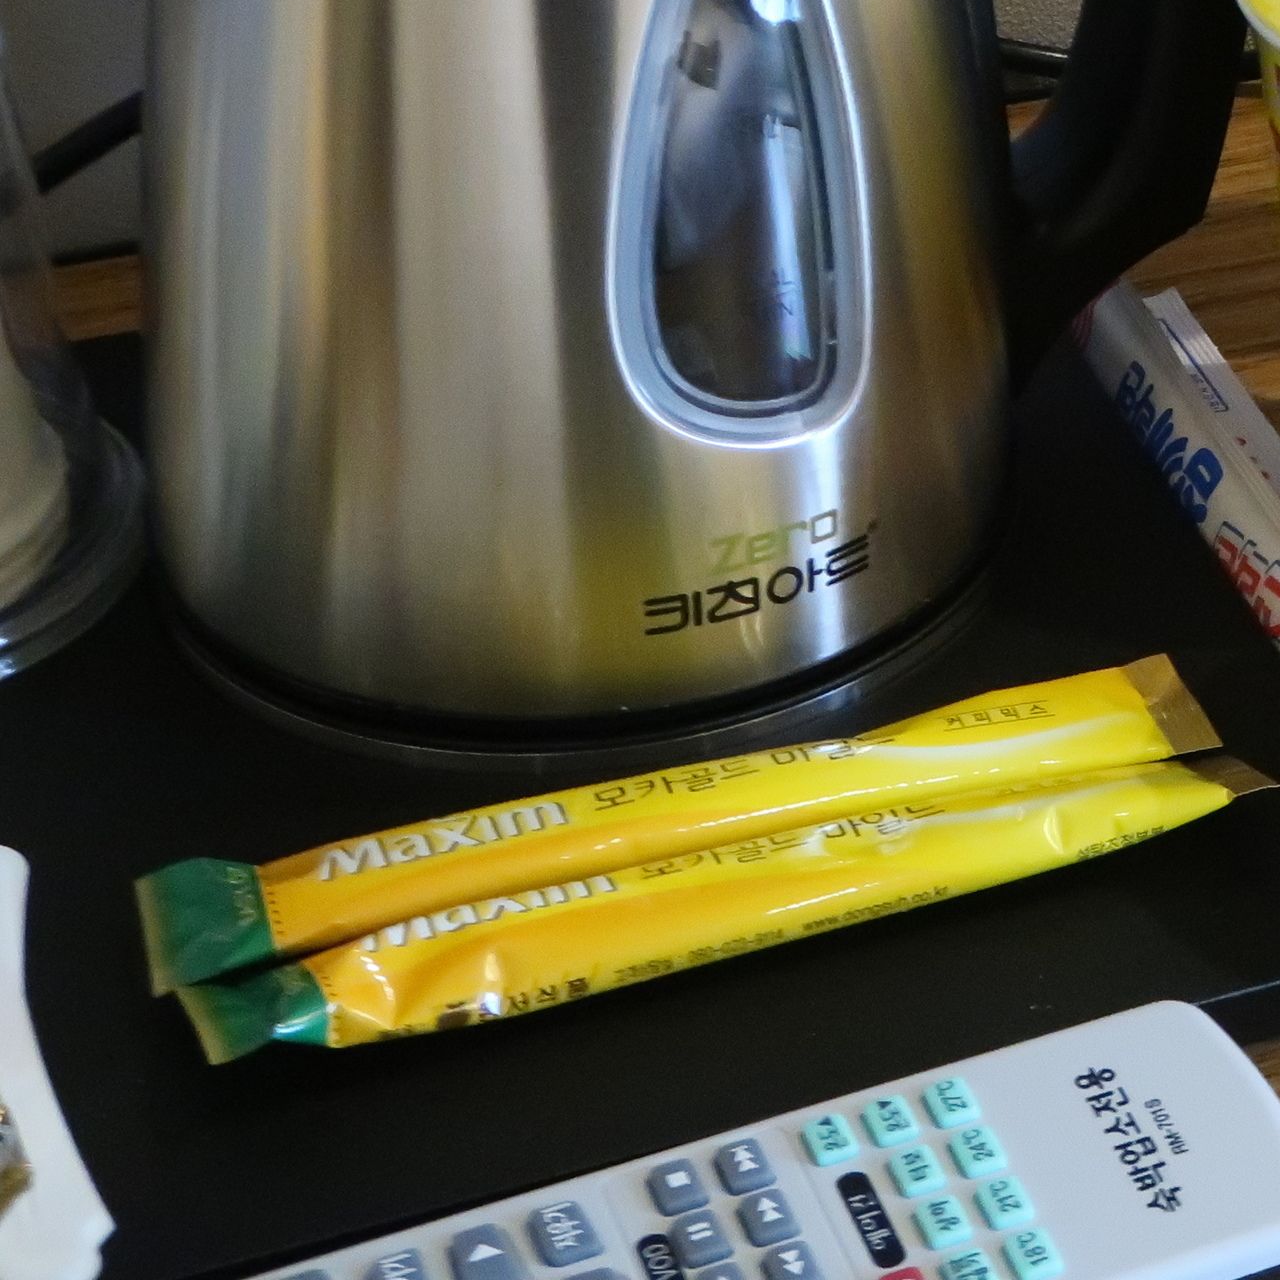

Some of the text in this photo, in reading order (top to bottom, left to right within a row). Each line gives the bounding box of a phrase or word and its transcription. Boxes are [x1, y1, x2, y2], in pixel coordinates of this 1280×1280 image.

[319, 800, 569, 882] Maxim
[593, 756, 760, 812] 모카골드
[943, 700, 1049, 723] 커피믹스
[820, 802, 946, 840] 마일드
[1073, 1066, 1183, 1213] 숙박업소전용
